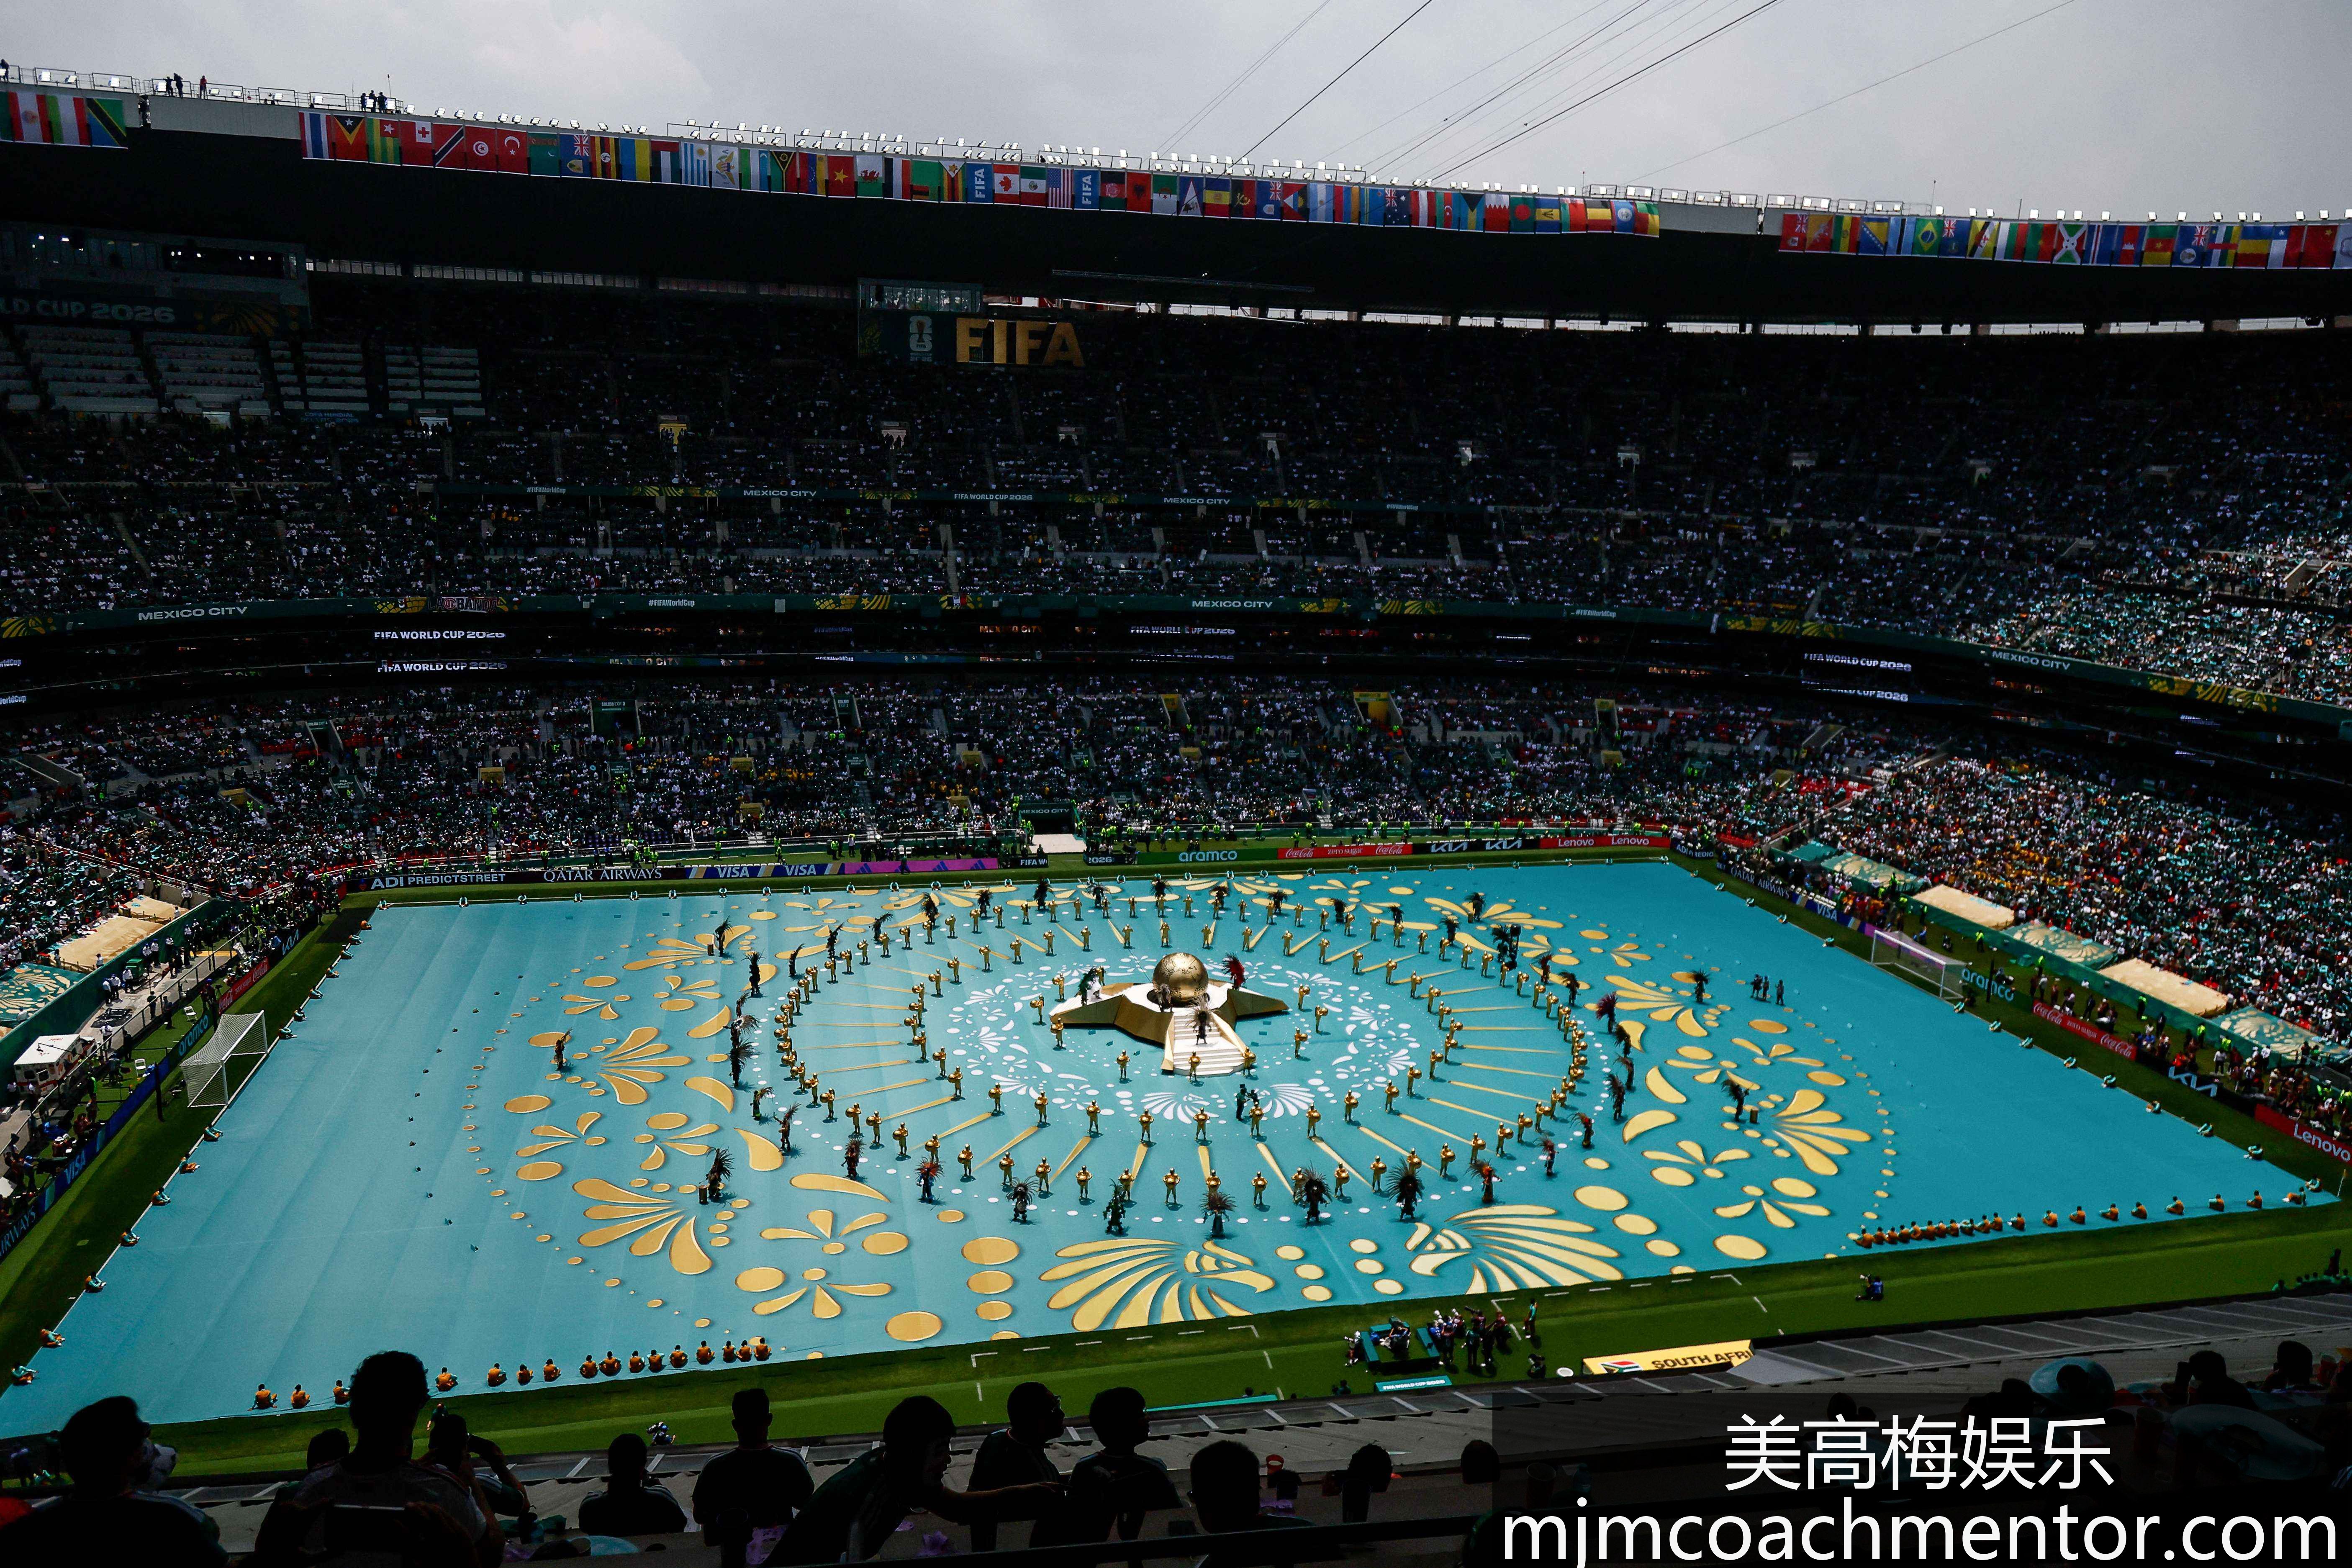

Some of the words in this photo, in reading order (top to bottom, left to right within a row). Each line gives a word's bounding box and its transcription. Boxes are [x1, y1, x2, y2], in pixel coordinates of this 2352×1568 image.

[975, 168, 985, 198] FIFA
[1082, 175, 1092, 205] FIFA
[36, 299, 85, 318] CUP
[91, 303, 176, 325] 2026
[955, 318, 1086, 367] FIFA
[138, 608, 205, 621] MEXICO
[208, 606, 248, 616] CITY
[402, 663, 444, 672] WORLD
[1804, 653, 1825, 661] FIFA
[1825, 654, 1859, 666] WORLD
[1860, 657, 1879, 667] CUP
[1880, 660, 1912, 672] 2026
[1992, 650, 2039, 665] MEXICO
[2041, 659, 2070, 670] CITY
[1876, 691, 1909, 703] 2026
[1558, 838, 1595, 847] Lenovo
[1612, 837, 1650, 846] Lenovo
[1179, 850, 1238, 862] aramco
[544, 869, 593, 883] QATAR
[600, 868, 662, 881] AIRWAYS
[716, 866, 750, 878] VISA
[784, 865, 817, 876] VISA
[371, 876, 404, 890] ADI
[408, 874, 506, 885] PREDICTSTREET
[1757, 878, 1790, 899] AIRWAYS
[1962, 968, 2015, 1002] aramco
[178, 1014, 209, 1057] aramco
[2293, 1123, 2352, 1162] Lenovo
[63, 1150, 86, 1185] VISA
[1651, 1355, 1712, 1370] SOUTH
